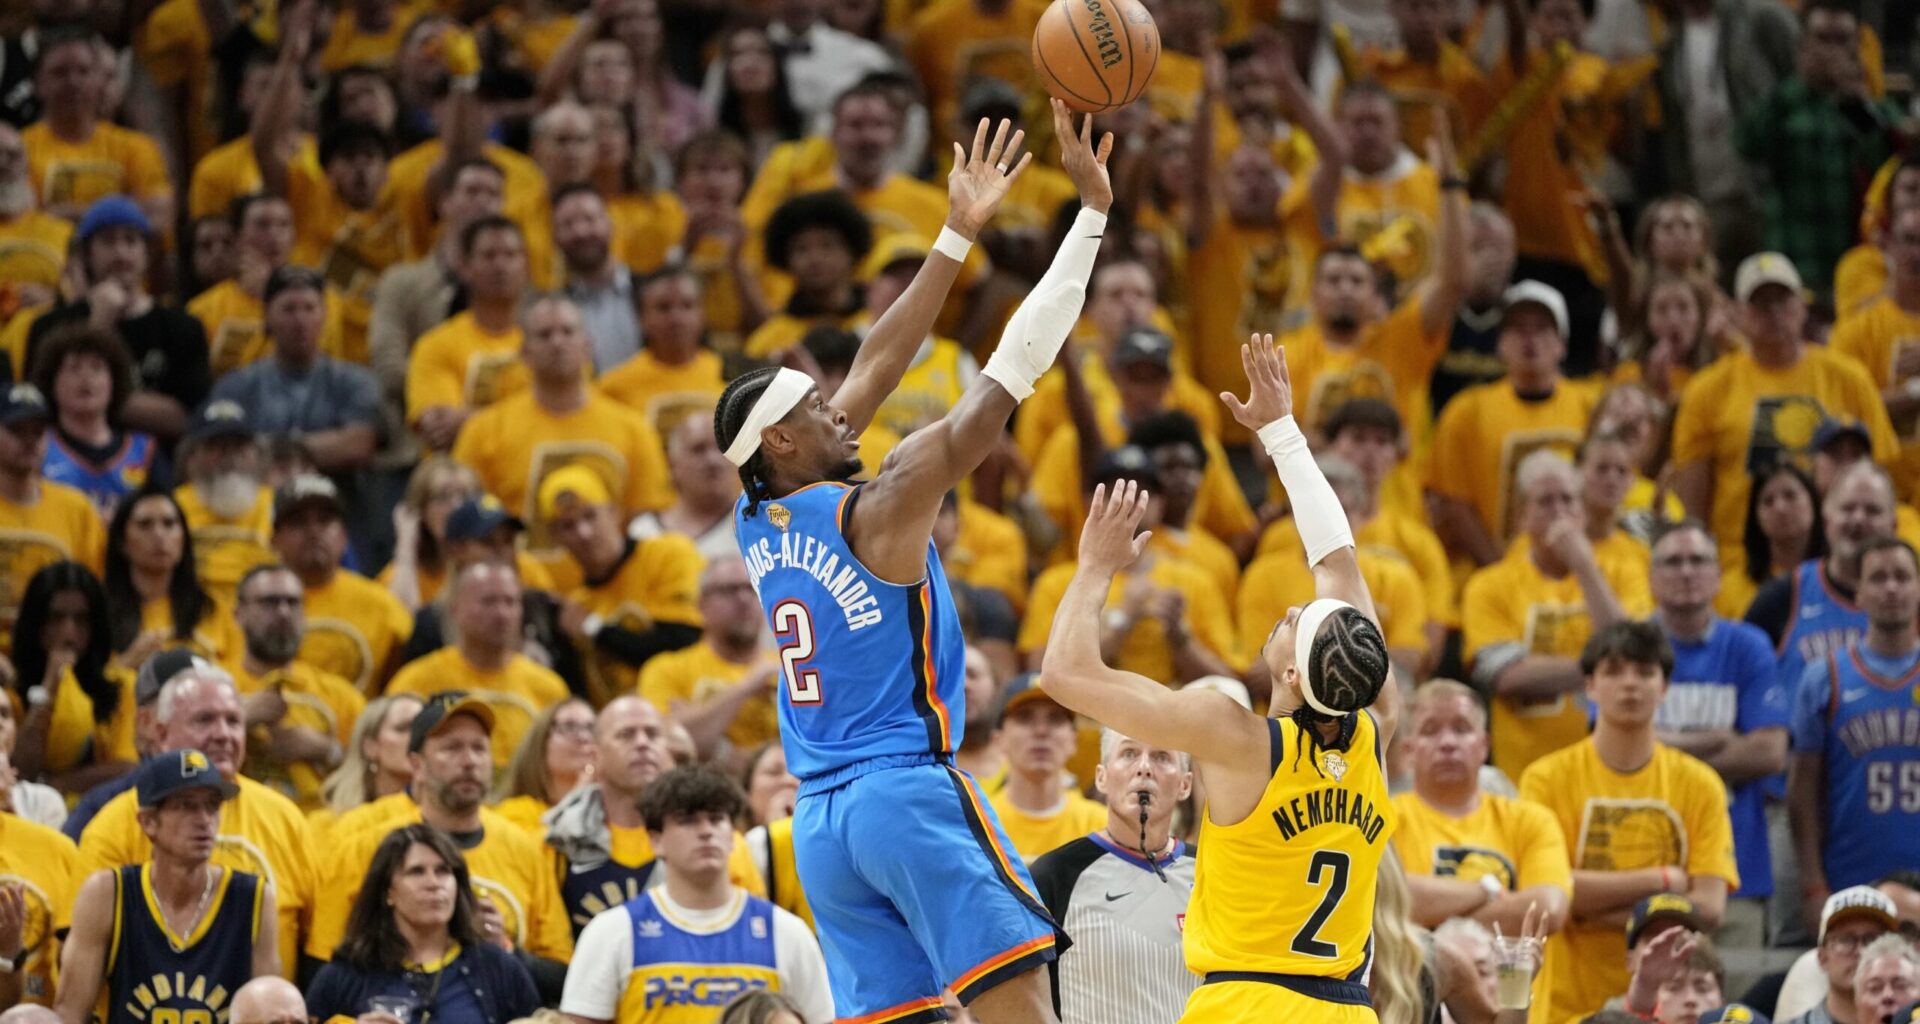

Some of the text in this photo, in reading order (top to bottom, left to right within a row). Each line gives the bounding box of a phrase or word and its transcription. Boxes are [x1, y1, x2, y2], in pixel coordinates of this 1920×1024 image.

[1085, 0, 1123, 69] Wilso
[745, 532, 882, 631] OUS-ALEXANDER
[771, 597, 823, 706] 2
[1838, 706, 1920, 759] THUND
[1272, 788, 1385, 845] NEMBHARD
[1868, 761, 1920, 816] 55
[572, 877, 639, 926] INDI
[1290, 849, 1350, 958] 2
